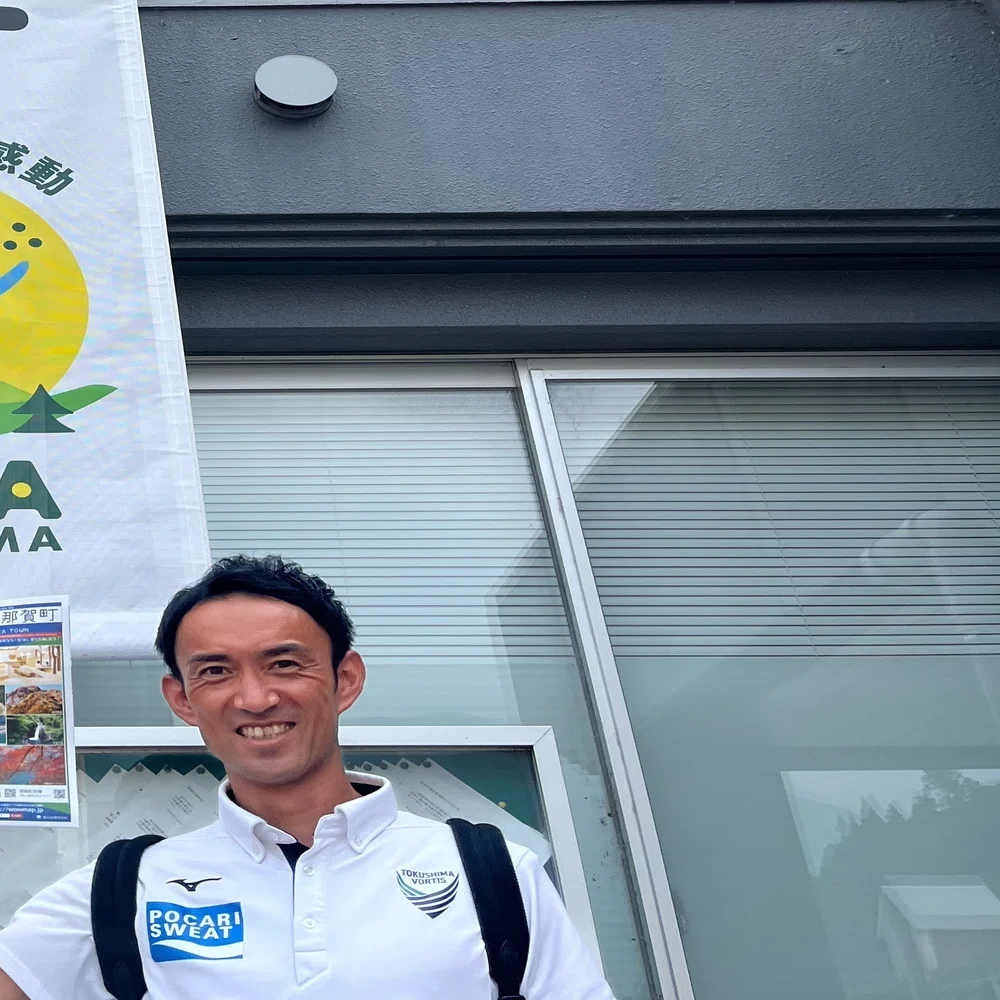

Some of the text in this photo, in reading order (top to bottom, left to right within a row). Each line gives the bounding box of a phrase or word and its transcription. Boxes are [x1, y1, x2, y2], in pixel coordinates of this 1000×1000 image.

[1, 608, 59, 624] 那賀町
[400, 869, 455, 879] TOKUSHIMA
[410, 877, 447, 885] VORTIS
[149, 910, 241, 928] POCARI
[149, 923, 234, 940] SWEAT
